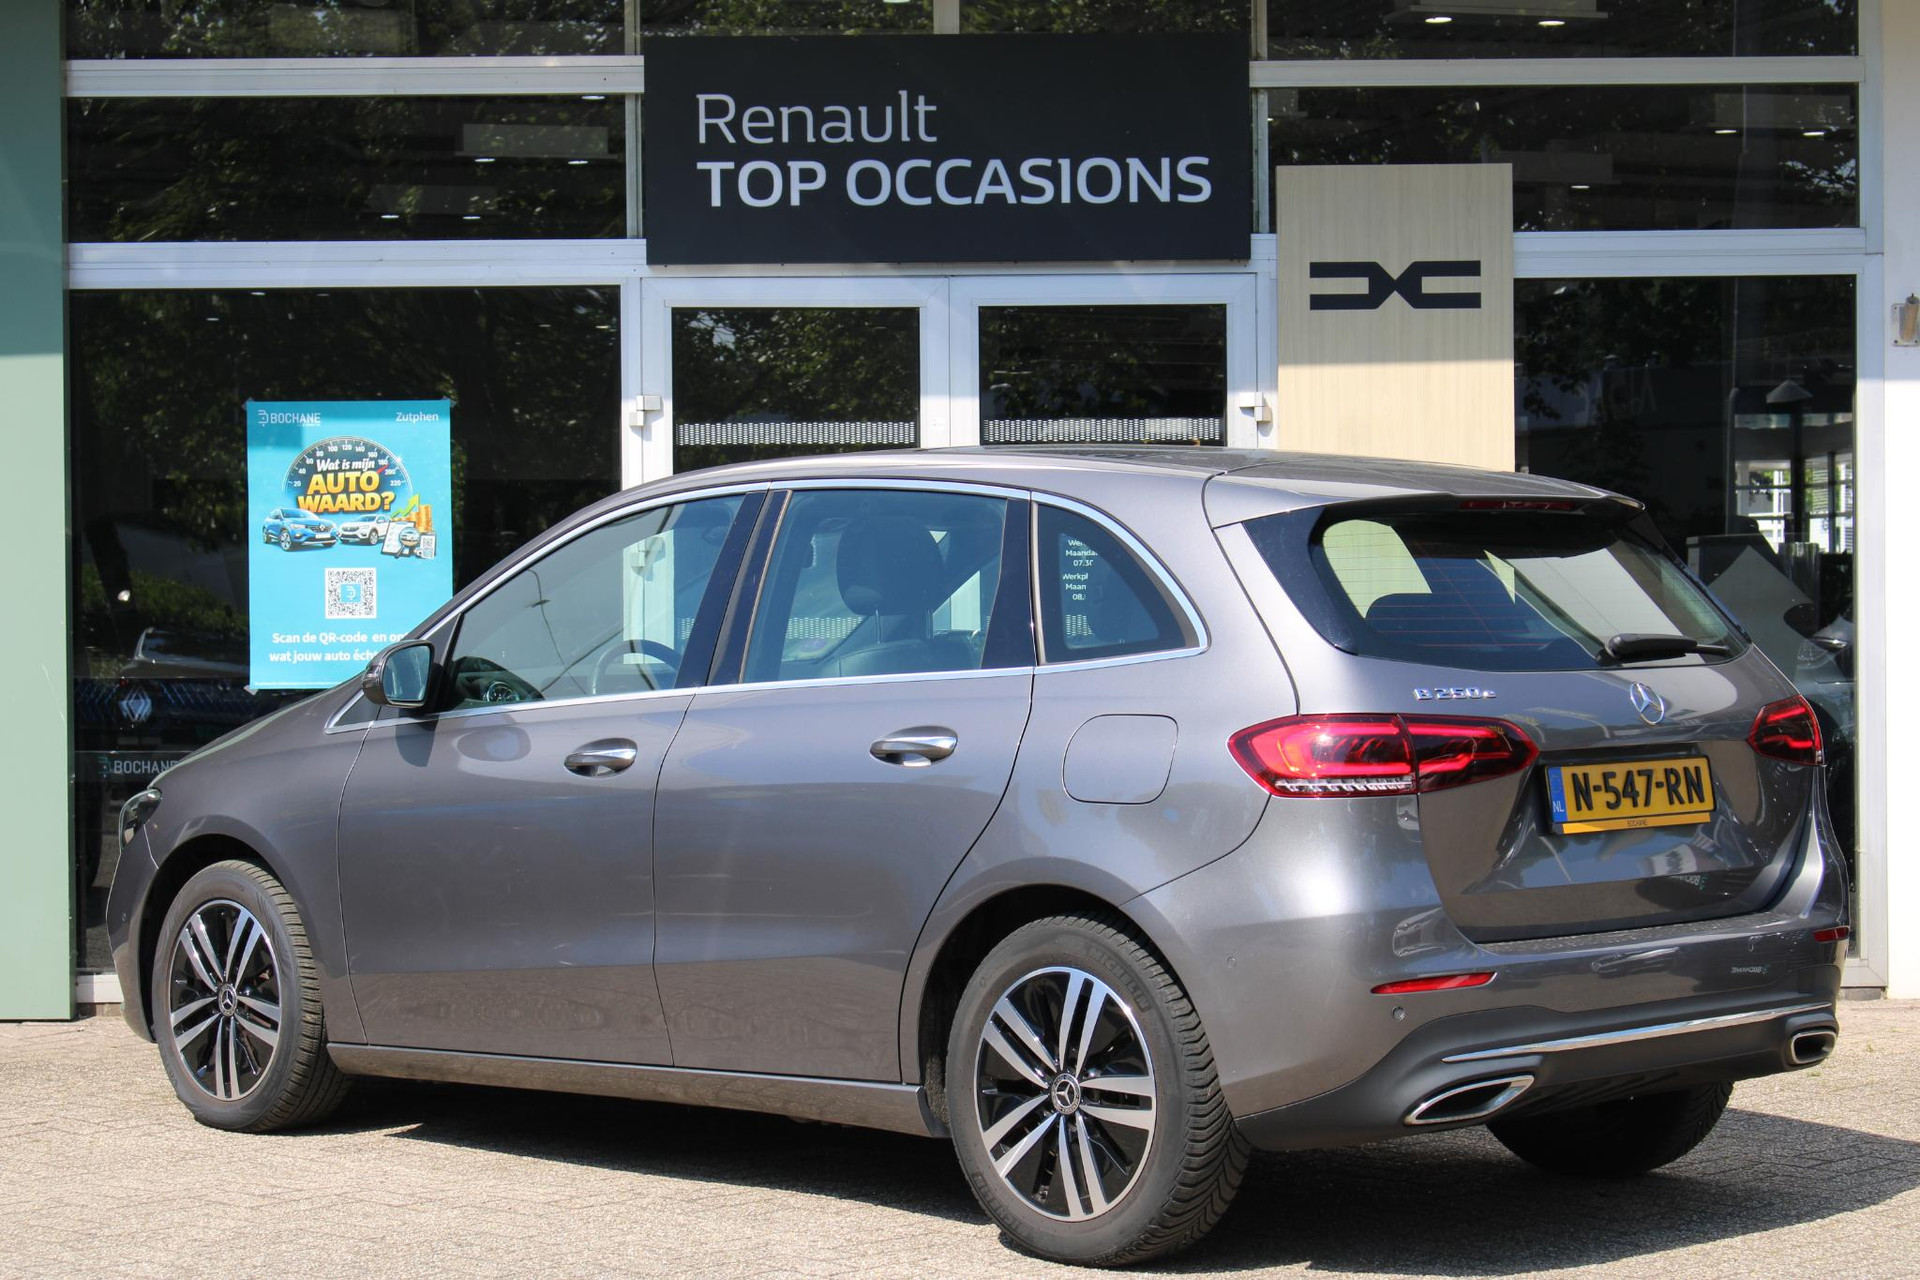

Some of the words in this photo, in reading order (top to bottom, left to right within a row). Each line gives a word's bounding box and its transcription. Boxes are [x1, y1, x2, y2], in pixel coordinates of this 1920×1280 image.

[696, 90, 937, 144] Renault
[696, 160, 826, 207] TOP
[846, 156, 1212, 206] OCCASIONS
[271, 413, 321, 424] BOCHANE
[395, 411, 439, 425] Zutphen
[316, 459, 340, 471] Wat
[342, 459, 350, 470] is
[351, 458, 375, 471] mijn
[306, 470, 380, 495] AUTO
[298, 491, 395, 513] WAARD?
[272, 632, 300, 643] Scan
[302, 632, 317, 643] de
[319, 632, 367, 645] QR-code
[372, 634, 387, 643] en
[269, 652, 291, 662] wat
[292, 651, 321, 664] jouw
[324, 652, 350, 662] auto
[1413, 688, 1433, 700] B
[1571, 766, 1705, 812] N-547-RN
[1552, 801, 1564, 812] NL
